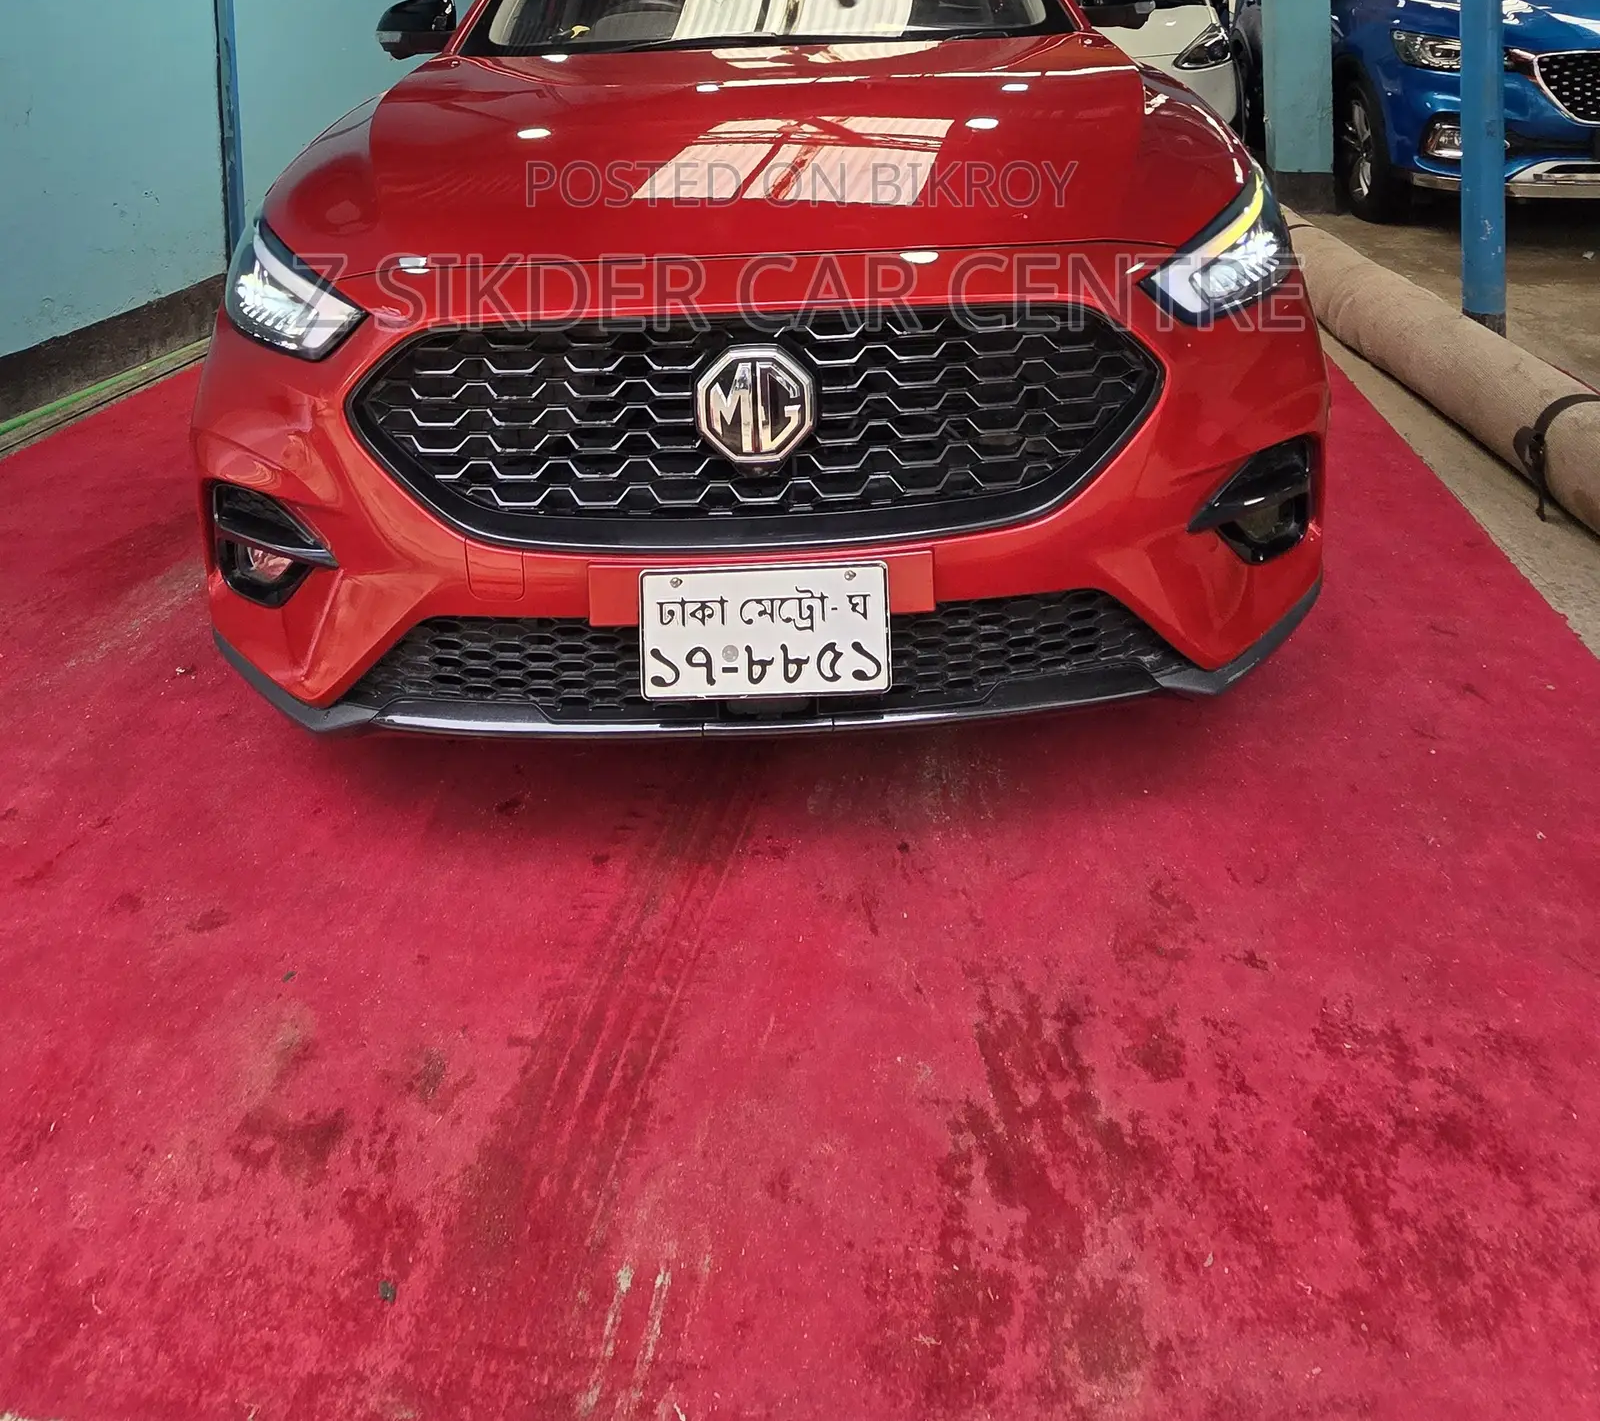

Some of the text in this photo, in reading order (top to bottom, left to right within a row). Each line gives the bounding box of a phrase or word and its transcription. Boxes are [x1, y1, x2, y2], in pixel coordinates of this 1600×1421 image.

[709, 360, 802, 454] MG
[656, 595, 729, 628] ঢাকা
[649, 640, 883, 688] ১৭-৮৮৫১
